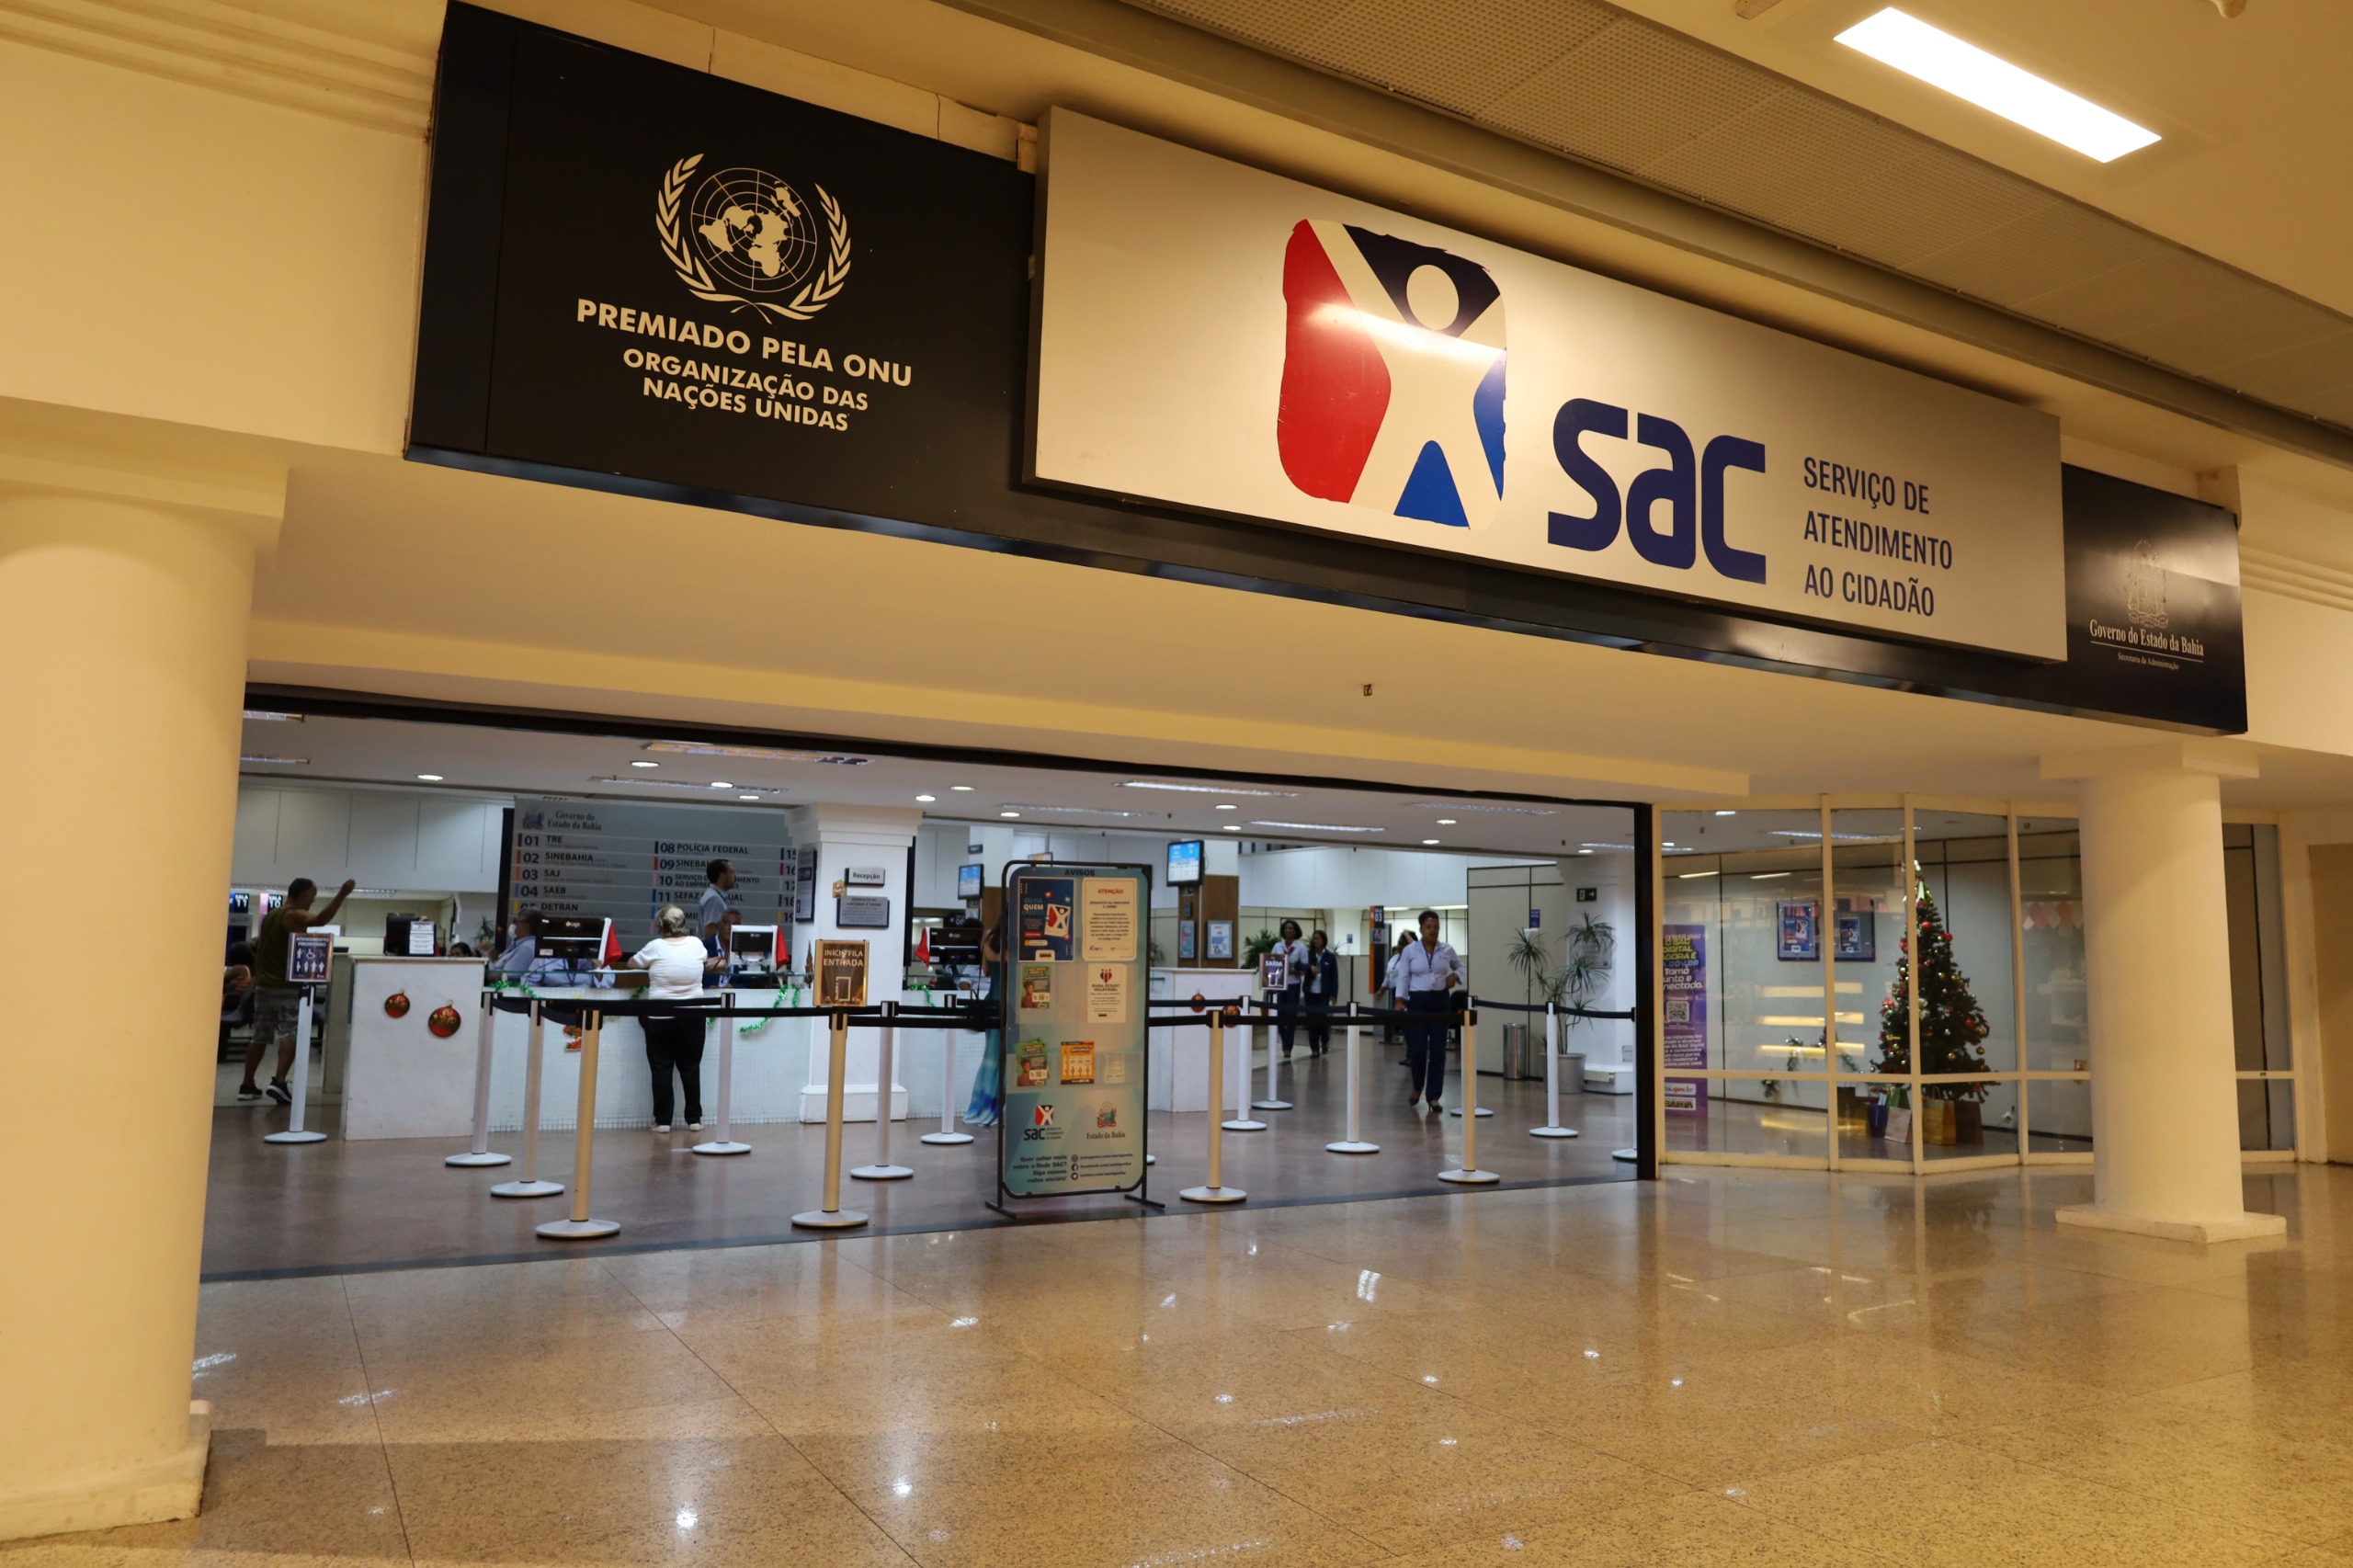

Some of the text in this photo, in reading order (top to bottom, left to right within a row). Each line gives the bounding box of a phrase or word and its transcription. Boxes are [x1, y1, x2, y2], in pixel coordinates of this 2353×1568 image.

[577, 298, 912, 386] PREMIADO PELA ONU
[623, 348, 869, 411] ORGANIZAÇÃO DAS
[643, 377, 848, 432] NAÇÕES UNIDAS
[1803, 457, 1929, 515] SERVIÇO DE
[1803, 510, 1952, 570] ATENDIMENTO
[1804, 564, 1934, 617] AO CIDADÃO
[2090, 619, 2126, 642] Governo
[2129, 627, 2138, 643] do
[2140, 629, 2167, 649] Estado
[2169, 634, 2179, 652] da
[2181, 636, 2204, 656] Bahia
[2118, 653, 2140, 664] Secretaria
[555, 811, 585, 820] Governo
[572, 820, 581, 828] da
[583, 822, 601, 831] Bahia
[524, 835, 563, 846] 01 TRE
[660, 842, 675, 853] 08
[677, 843, 710, 852] POLÍCIA
[713, 846, 749, 855] FEDERAL
[523, 852, 594, 864] 02 SINEBAHIA
[660, 859, 675, 869] 09
[522, 869, 539, 881] 03
[659, 875, 673, 886] 10
[676, 874, 702, 882] SERVIÇO
[853, 871, 881, 880] Recepção
[520, 886, 539, 897] 04
[544, 886, 566, 894] SAEB
[658, 892, 669, 903] 11
[675, 892, 699, 900] SEFAZ
[541, 903, 579, 912] DETRAN
[1375, 913, 1382, 922] 03
[1691, 951, 1697, 960] É
[824, 958, 864, 967] ENTRADA
[1086, 1131, 1103, 1140] Estado
[1111, 1131, 1126, 1139] Bahia
